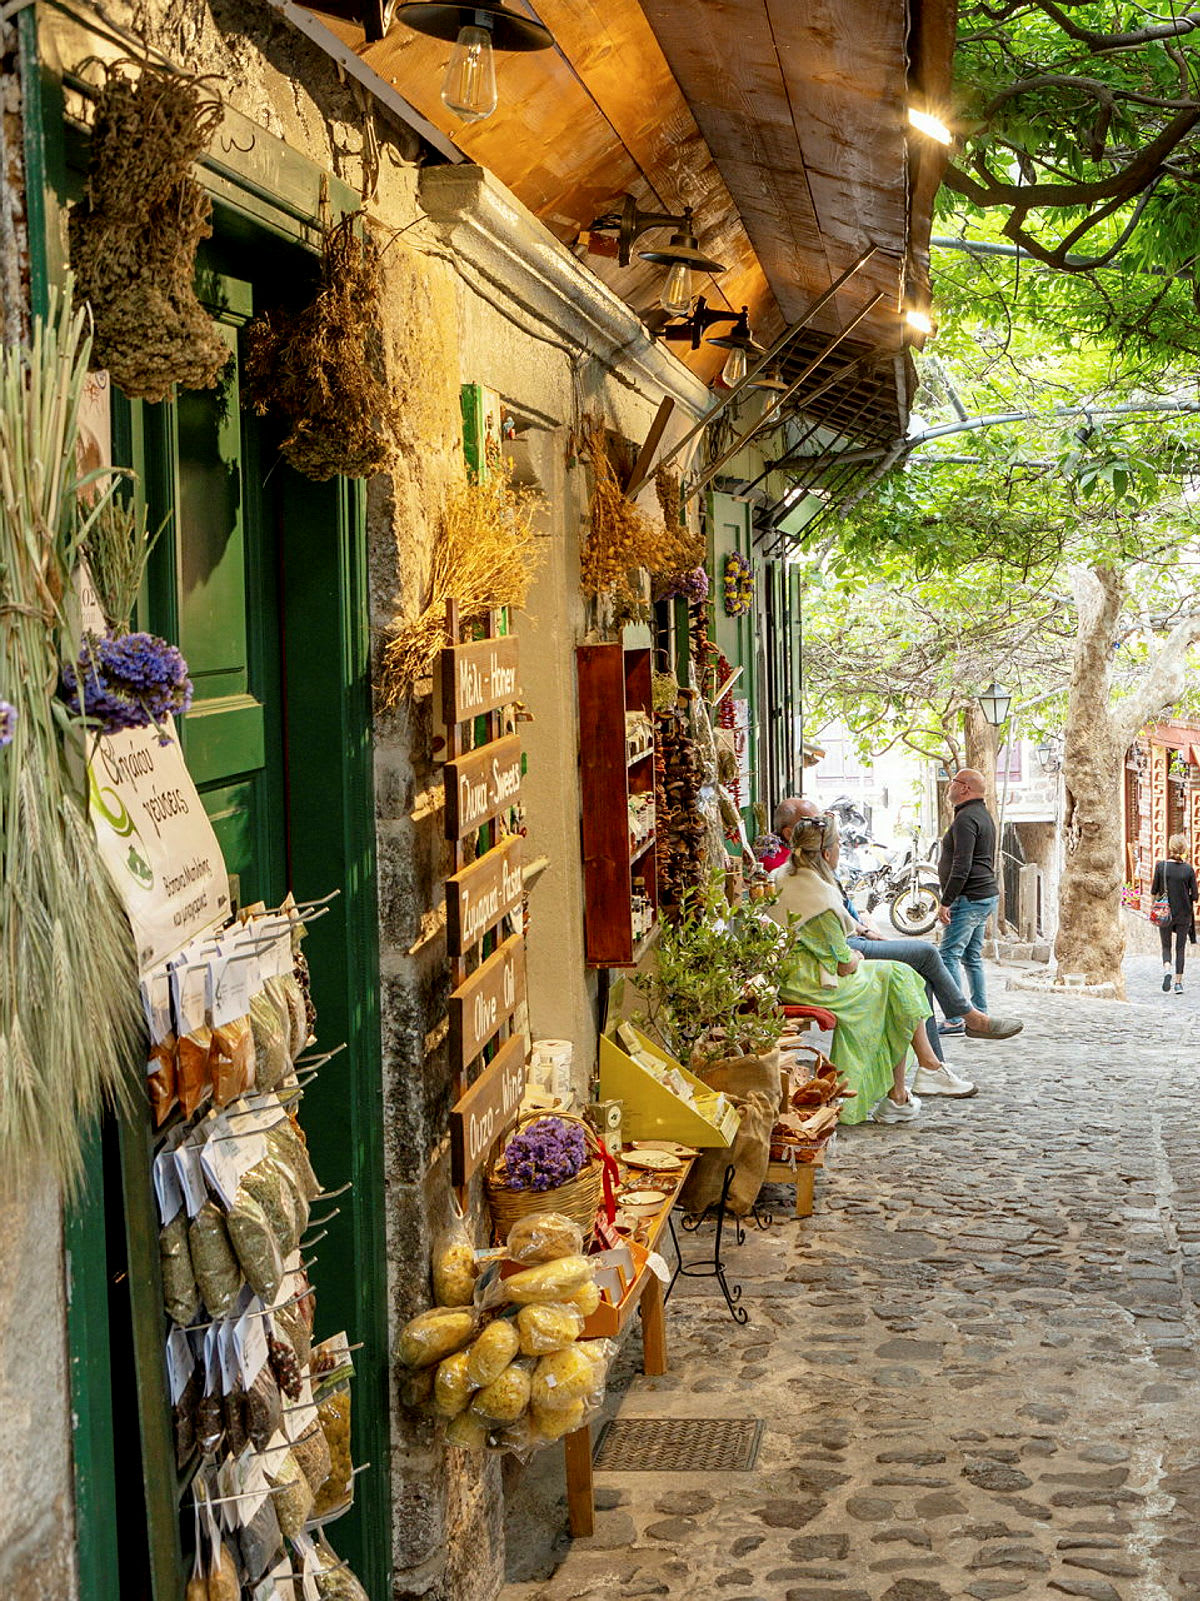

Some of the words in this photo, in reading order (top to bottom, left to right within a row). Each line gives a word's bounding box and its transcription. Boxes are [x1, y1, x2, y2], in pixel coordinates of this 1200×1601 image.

[490, 652, 516, 699] Honey
[493, 757, 521, 804] Sweets
[142, 784, 190, 839] γεύσεις
[1153, 758, 1165, 859] RESTAURA
[502, 858, 523, 906] Pasta
[474, 991, 497, 1042] Olive
[504, 957, 515, 1009] Oil
[469, 1111, 494, 1160] Ouzo
[502, 1066, 523, 1112] Wine
